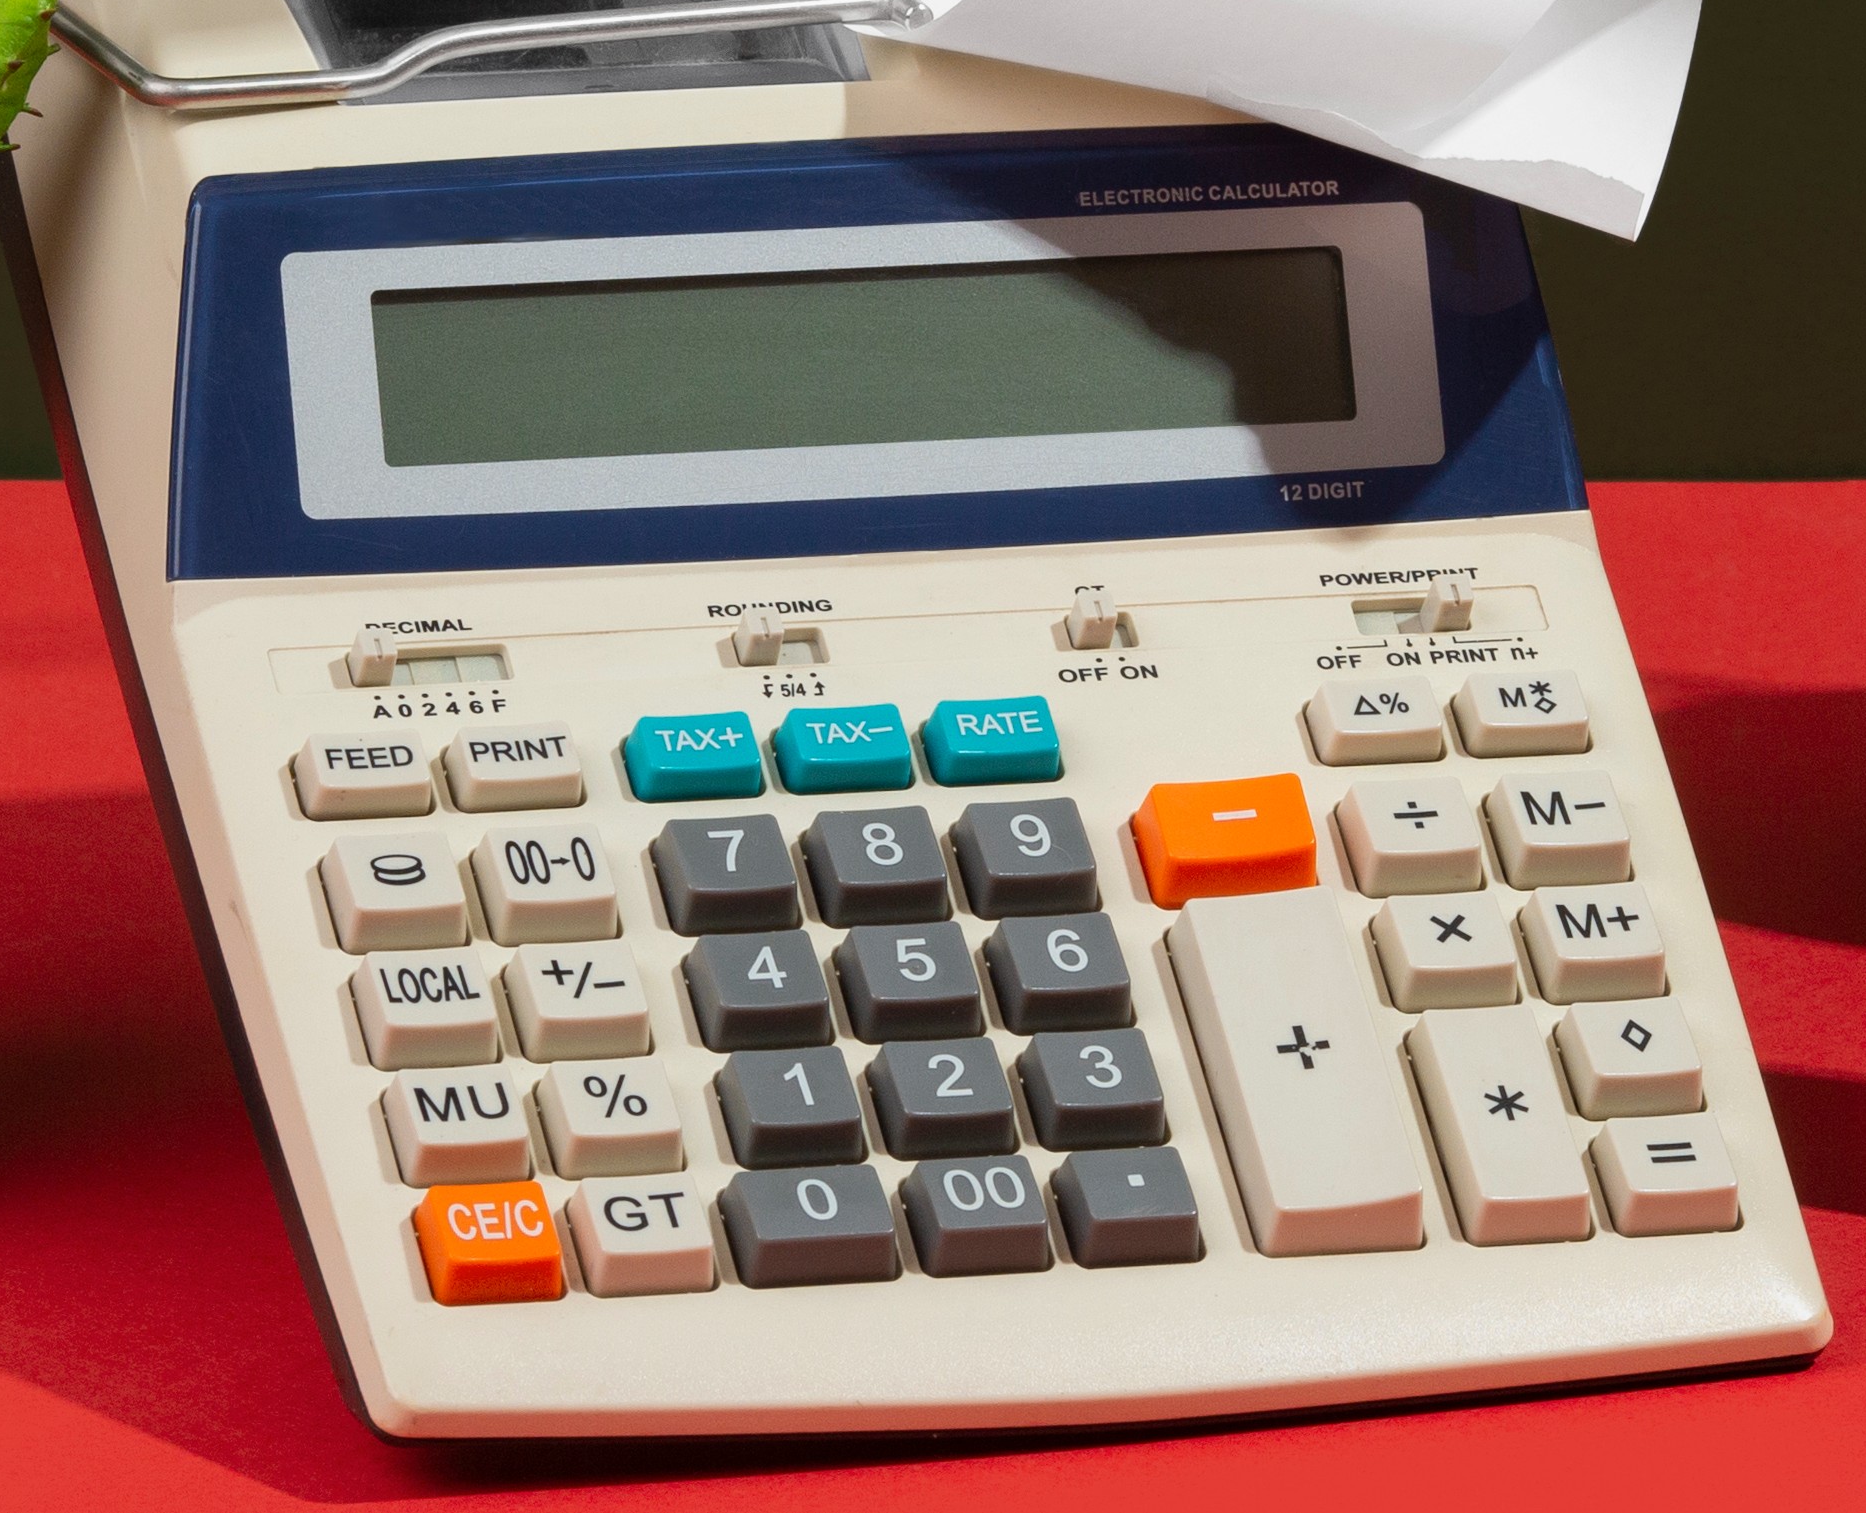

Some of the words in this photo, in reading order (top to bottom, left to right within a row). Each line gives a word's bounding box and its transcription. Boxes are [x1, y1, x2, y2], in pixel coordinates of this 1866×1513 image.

[1079, 186, 1203, 207] ELECTRONIC
[1208, 180, 1339, 201] CALCULATOR
[1280, 484, 1303, 502] 12
[1308, 481, 1365, 500] DIGIT
[707, 599, 833, 618] RODING
[1058, 667, 1108, 683] OFF
[1120, 665, 1158, 679] ON
[1316, 654, 1362, 670] OFF
[1386, 652, 1422, 666] ON
[1429, 647, 1499, 664] PRINT
[373, 705, 393, 719] A
[398, 704, 413, 718] 0
[422, 703, 438, 717] 2
[446, 701, 461, 715] 4
[469, 700, 484, 714] 6
[492, 699, 507, 713] F
[956, 711, 1043, 736] RATE
[325, 745, 414, 770] FEED
[469, 736, 566, 762] PRINT
[655, 727, 744, 752] TAX+
[707, 829, 745, 872] 7
[861, 822, 904, 866] 8
[1009, 814, 1052, 857] 9
[1555, 903, 1640, 939] M+
[747, 945, 787, 988] 4
[896, 938, 936, 982] 5
[1046, 929, 1089, 973] 6
[380, 965, 480, 1003] LOCAL
[783, 1062, 815, 1106] 1
[928, 1054, 974, 1098] 2
[1079, 1045, 1123, 1089] 3
[413, 1082, 510, 1122] MU
[796, 1178, 839, 1221] 0
[942, 1166, 1026, 1212] 00
[447, 1199, 544, 1241] CE/C
[603, 1191, 684, 1232] GT
